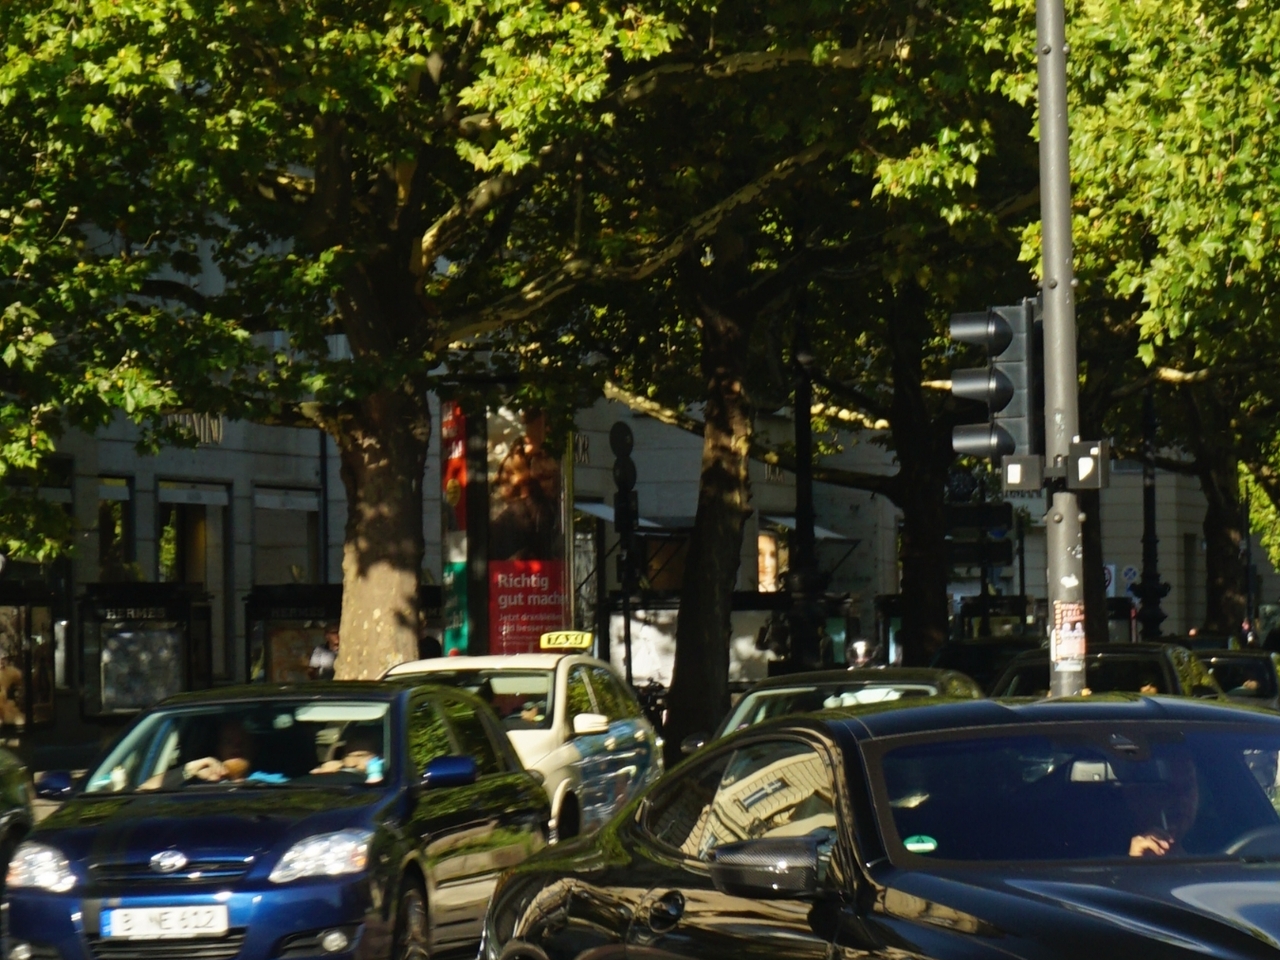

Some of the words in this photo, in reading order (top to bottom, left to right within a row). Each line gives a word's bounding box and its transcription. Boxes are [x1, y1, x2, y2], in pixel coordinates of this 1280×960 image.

[497, 572, 549, 591] Richtig
[497, 591, 524, 609] gut
[547, 633, 585, 645] TAXI
